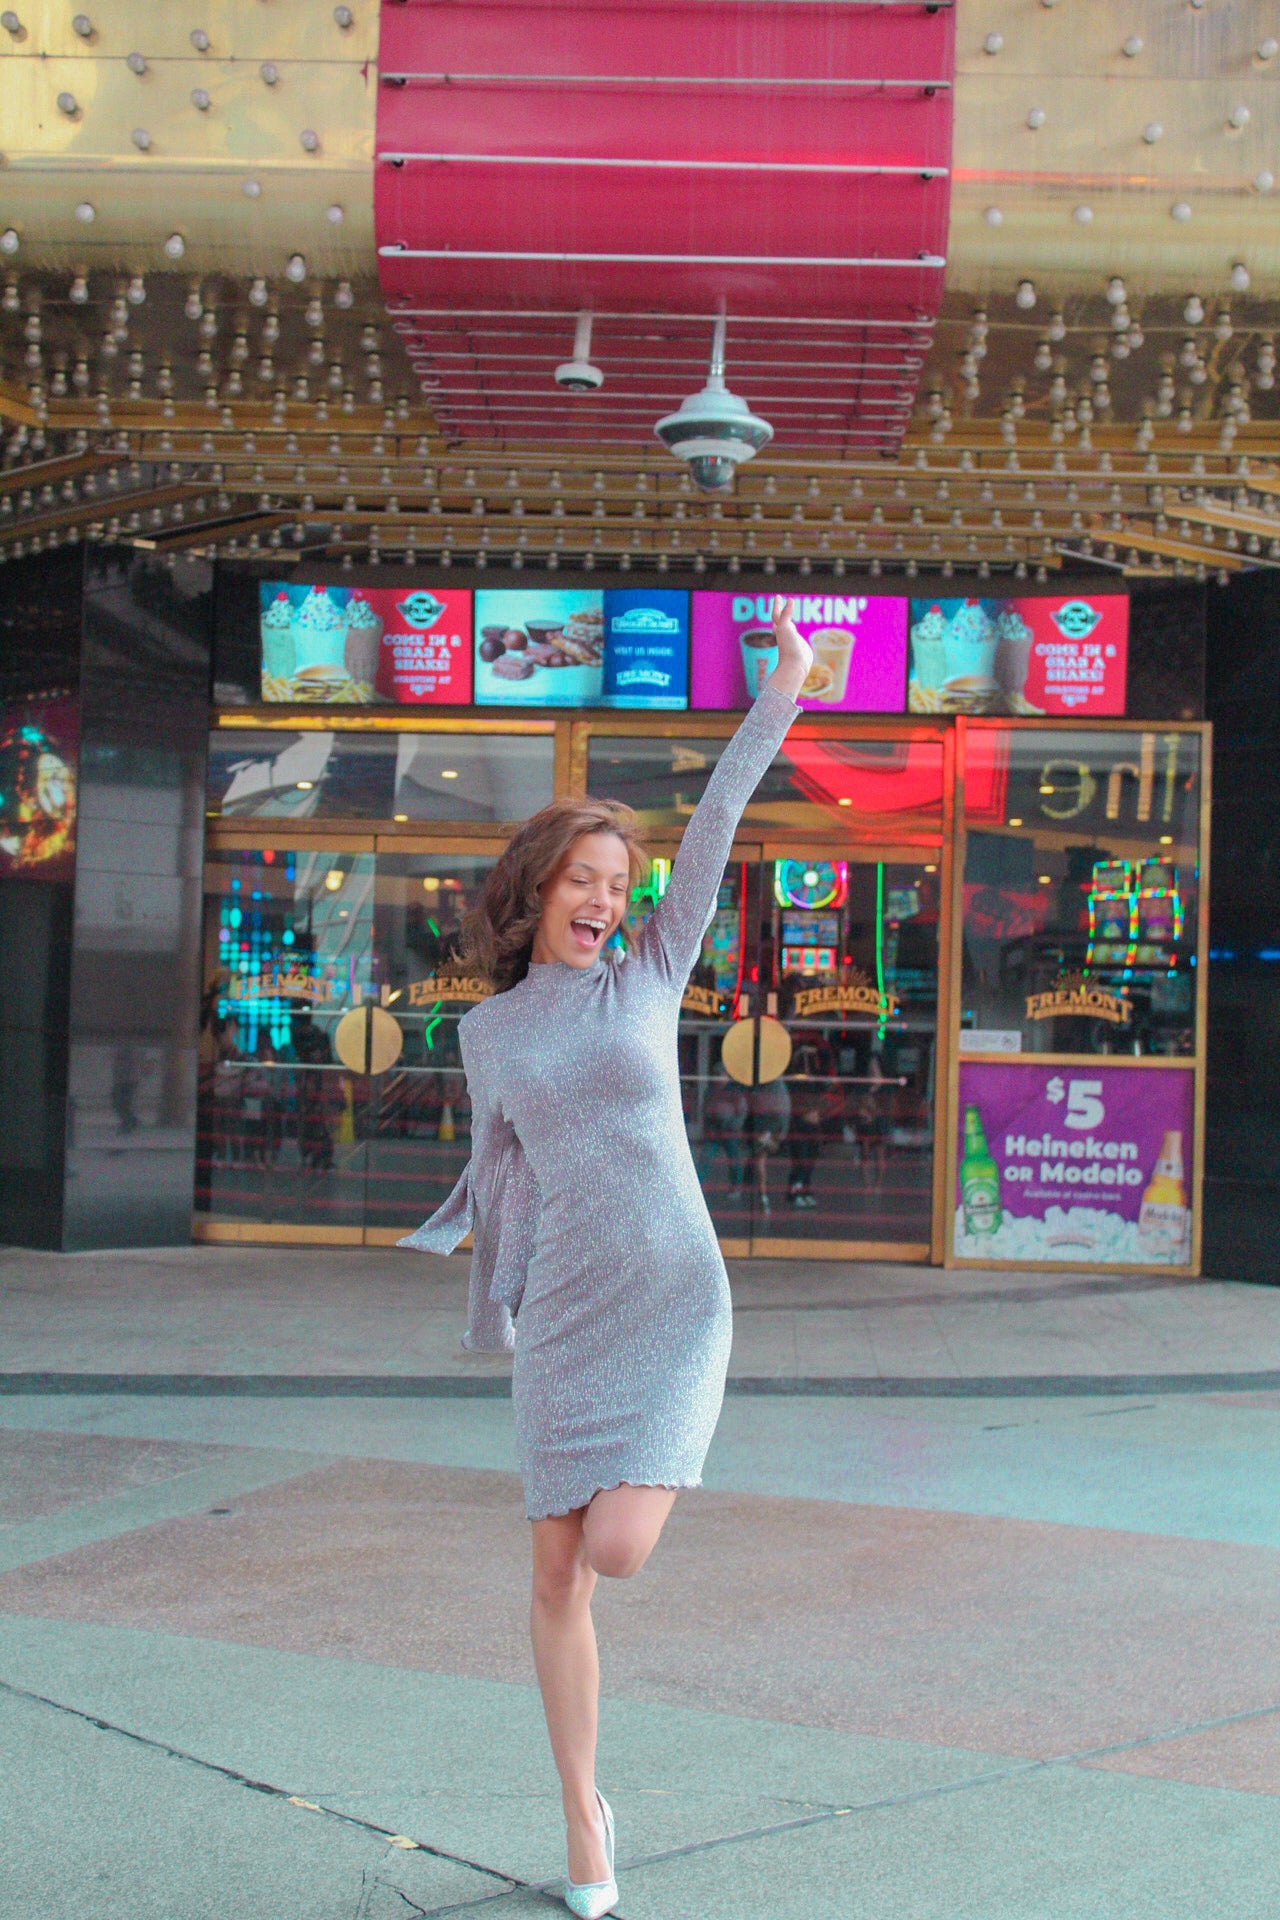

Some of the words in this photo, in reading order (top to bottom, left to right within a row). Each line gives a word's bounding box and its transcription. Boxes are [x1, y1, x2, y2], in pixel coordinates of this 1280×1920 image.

[383, 634, 424, 646] COME
[429, 634, 446, 646] IN
[393, 647, 434, 658] GRAB
[438, 647, 451, 659] A
[1035, 643, 1079, 656] COME
[1082, 644, 1101, 656] IN
[1045, 656, 1088, 668] GRAB
[1092, 656, 1105, 669] A
[408, 976, 496, 1004] FREMON
[794, 986, 900, 1016] FREMONT
[1025, 988, 1134, 1022] FREMONT
[1046, 1076, 1105, 1130] $5
[1005, 1133, 1138, 1160] Heineken
[1040, 1161, 1143, 1186] Modelo
